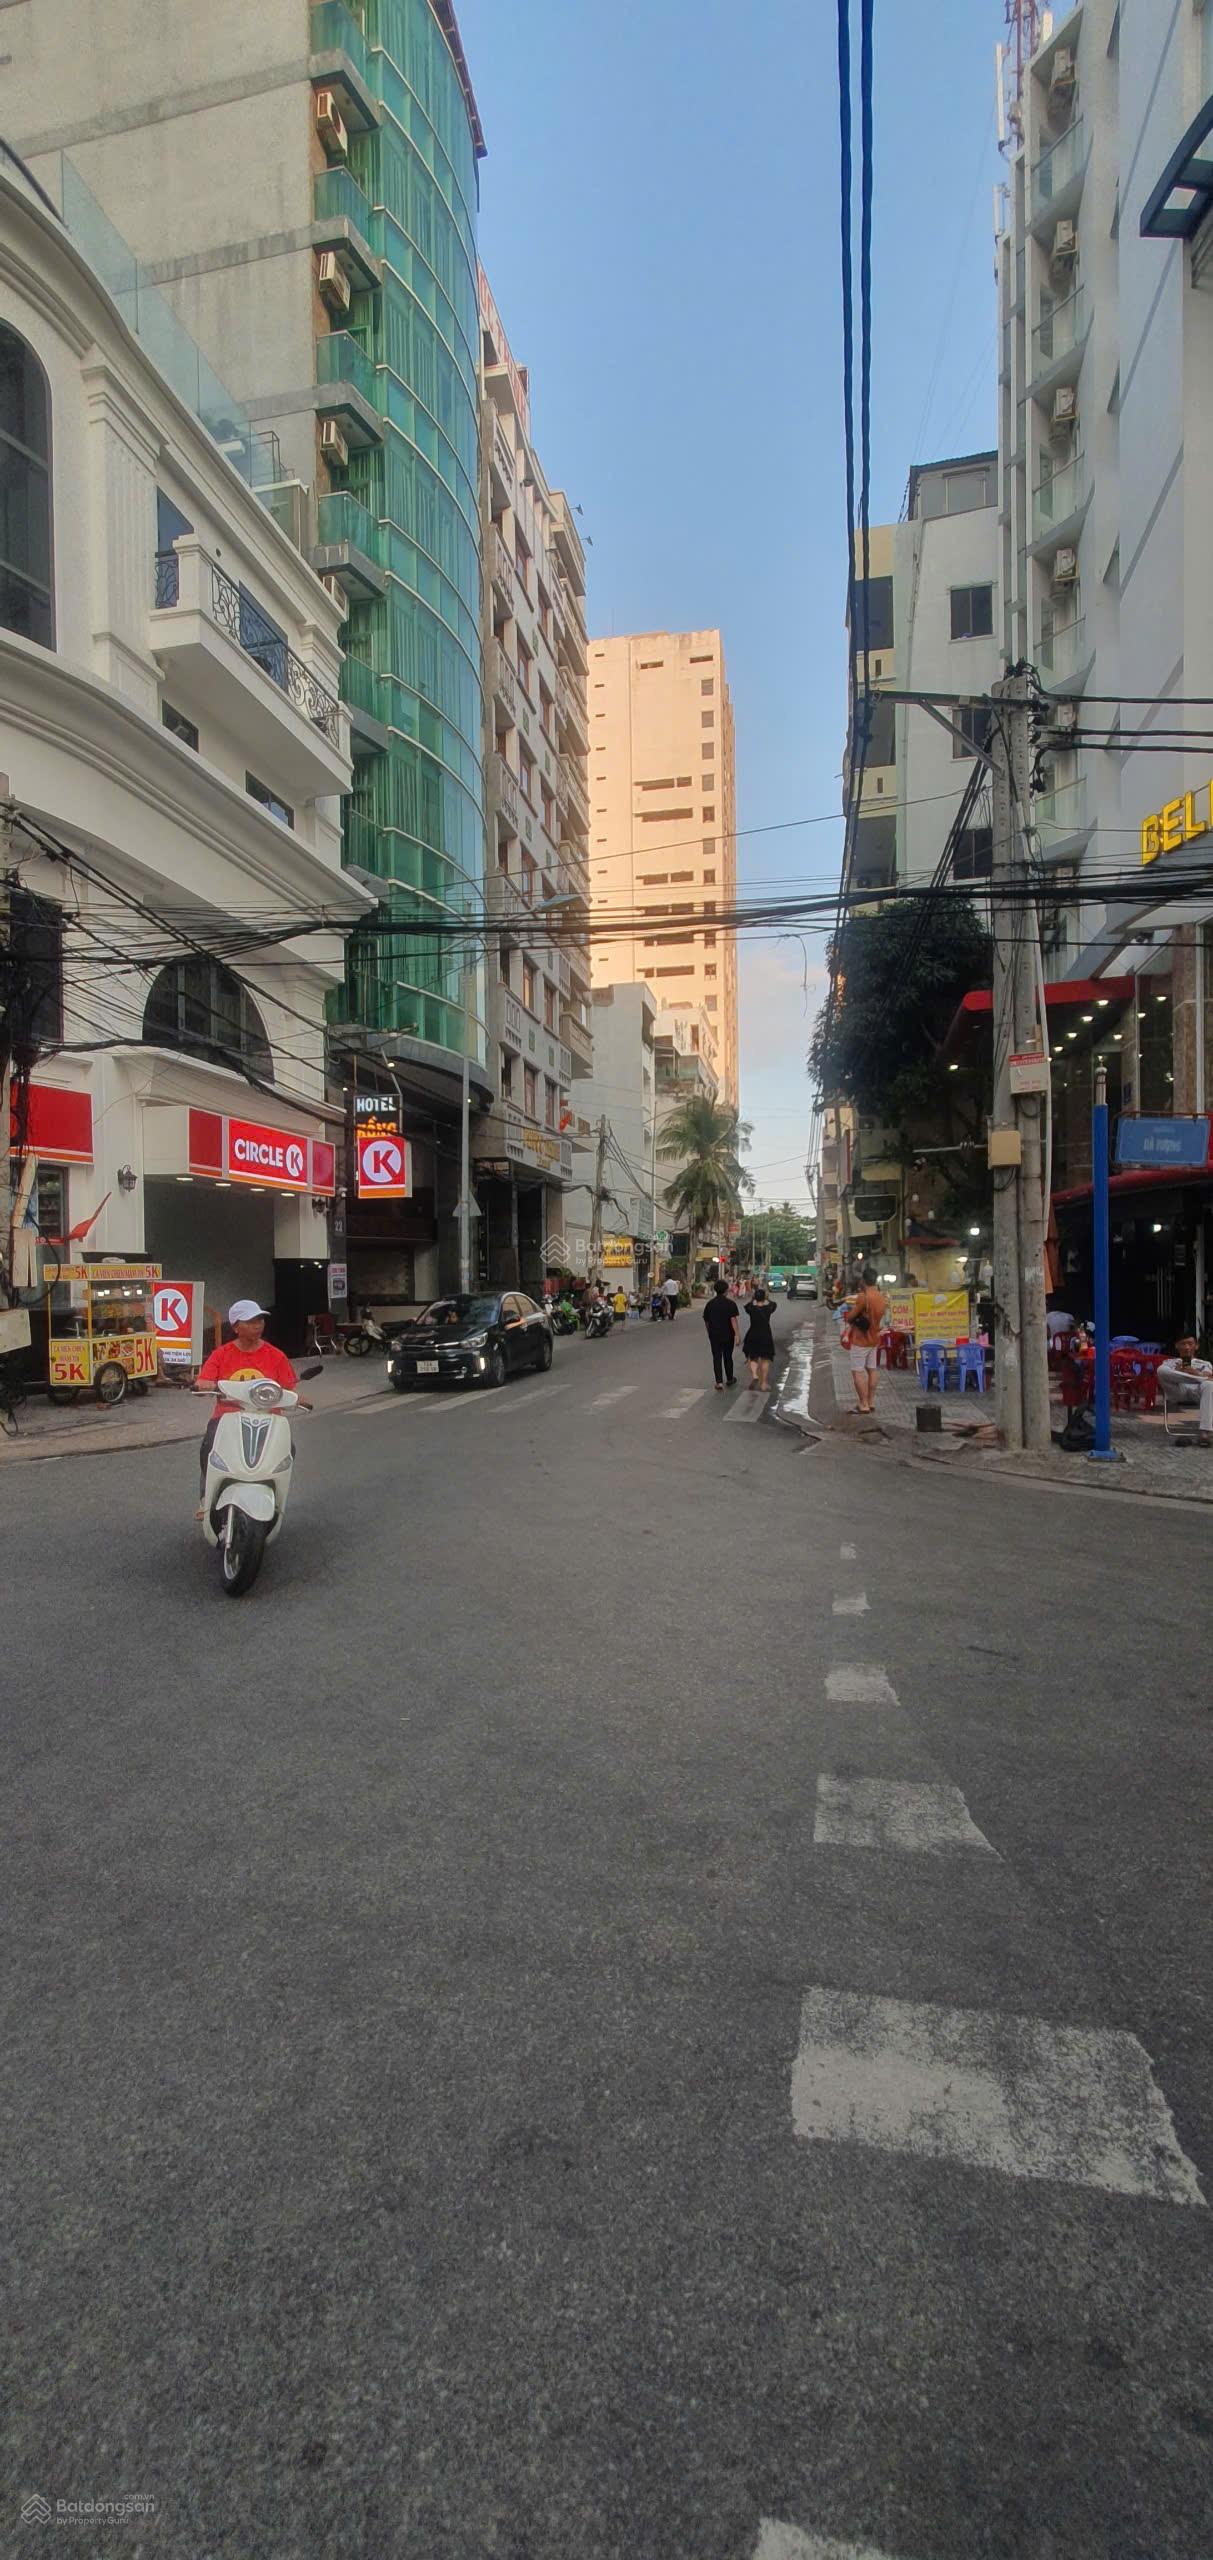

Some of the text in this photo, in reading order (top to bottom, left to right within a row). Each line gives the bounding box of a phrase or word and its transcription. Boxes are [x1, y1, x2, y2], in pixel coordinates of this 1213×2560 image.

[1142, 778, 1213, 865] BEL
[356, 1097, 397, 1112] HOTEL
[234, 1138, 303, 1175] CIRCLE K
[370, 1147, 400, 1181] K
[75, 1265, 88, 1279] 5K
[145, 1265, 160, 1279] 5K
[158, 1295, 185, 1329] K
[54, 1363, 85, 1381] 5K
[135, 1337, 154, 1373] 5K
